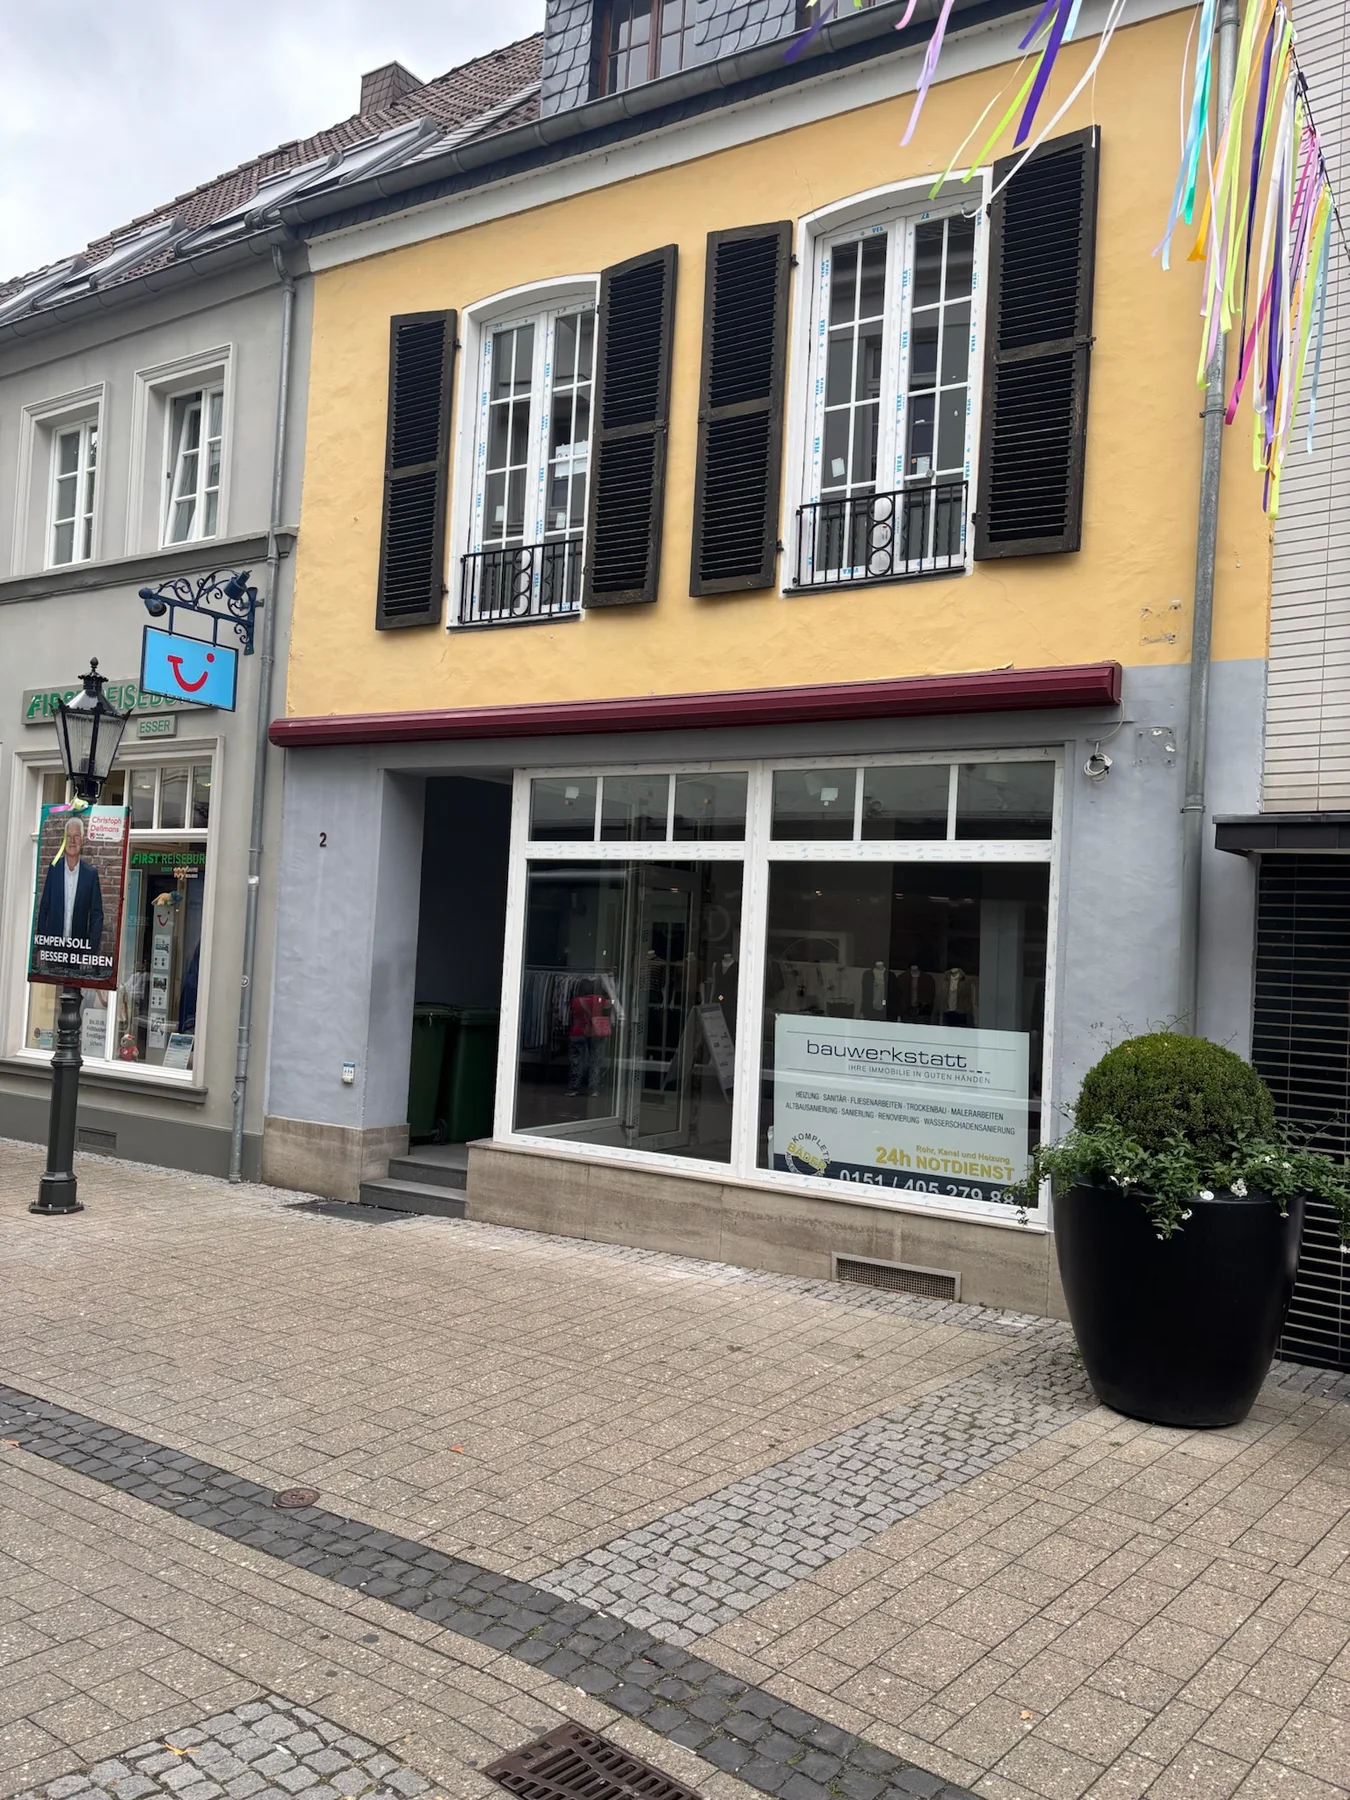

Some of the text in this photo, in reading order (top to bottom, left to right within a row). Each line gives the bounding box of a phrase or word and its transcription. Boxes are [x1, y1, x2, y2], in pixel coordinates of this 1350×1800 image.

[843, 567, 859, 575] VKA
[27, 691, 80, 718] FIR
[140, 720, 170, 733] ESSER
[92, 816, 122, 826] Christoph
[319, 832, 327, 848] 2
[131, 853, 159, 865] FIRST
[34, 934, 92, 950] KEMPEN SOLL
[40, 950, 113, 968] BESSER BLEIBEN
[806, 1039, 967, 1069] bauwerkstatt
[848, 1064, 867, 1073] IHRE
[868, 1065, 911, 1077] IMMOBILIE
[924, 1071, 952, 1081] GUTEN
[954, 1073, 991, 1084] HÄNDEN
[795, 1090, 1004, 1121] HEIZUNG SANITÄR FLIESENARBEITEN TROCKENBAU MALERARBEITEN
[785, 1101, 1016, 1135] ALTBAUSANIERUNG SANIERUNG RENOVIERUNG WASSERSCHADENSANIERUNG
[791, 1133, 830, 1164] KOMPLETT
[938, 1147, 960, 1157] Kanal
[961, 1152, 977, 1160] und
[978, 1153, 1011, 1165] Heizung
[875, 1146, 1015, 1181] 24h NOTDIENST
[840, 1169, 883, 1186] 0151
